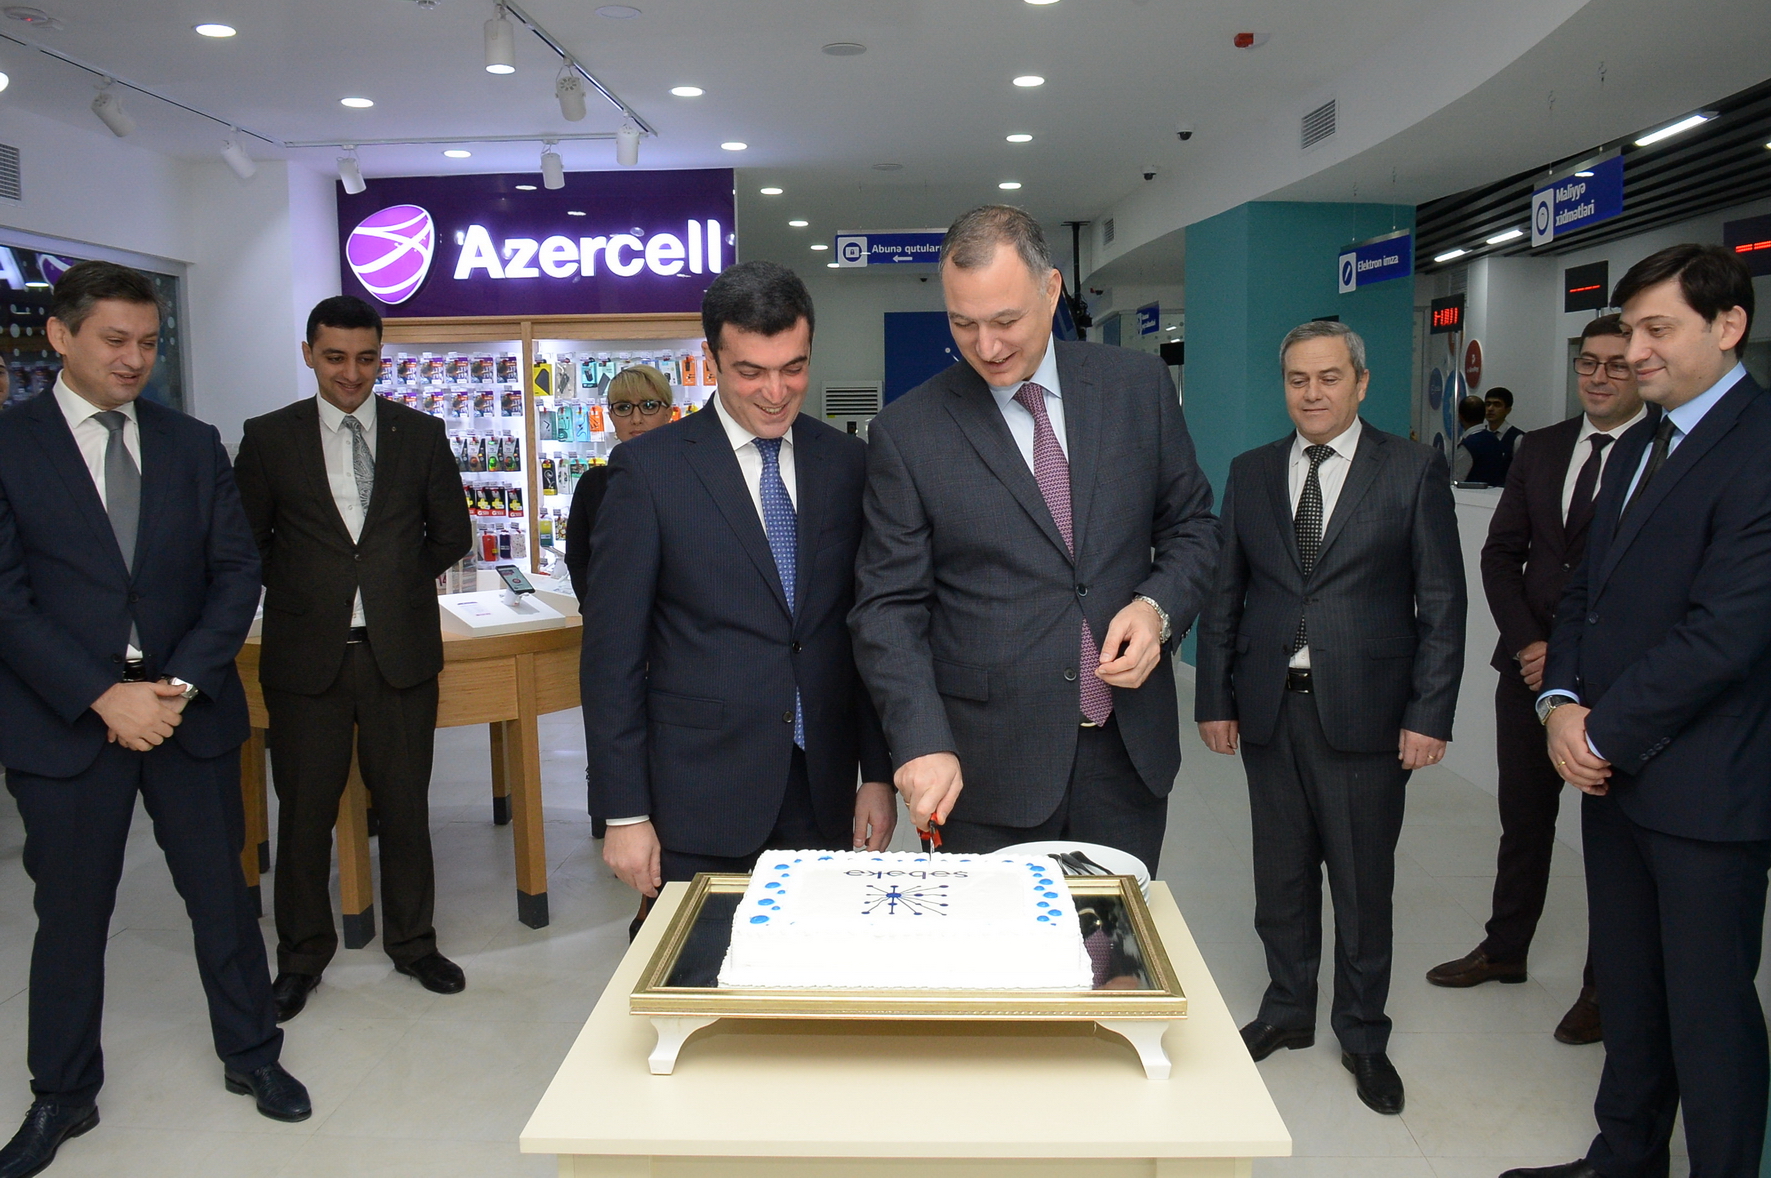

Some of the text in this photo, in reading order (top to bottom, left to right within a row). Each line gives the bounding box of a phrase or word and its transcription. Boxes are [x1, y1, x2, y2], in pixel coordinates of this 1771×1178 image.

[1556, 182, 1586, 203] Maliyyə
[1555, 200, 1595, 227] xidmətləri
[453, 219, 722, 280] Azercell
[871, 244, 902, 254] Abunə
[1357, 255, 1399, 272] Elektron imza
